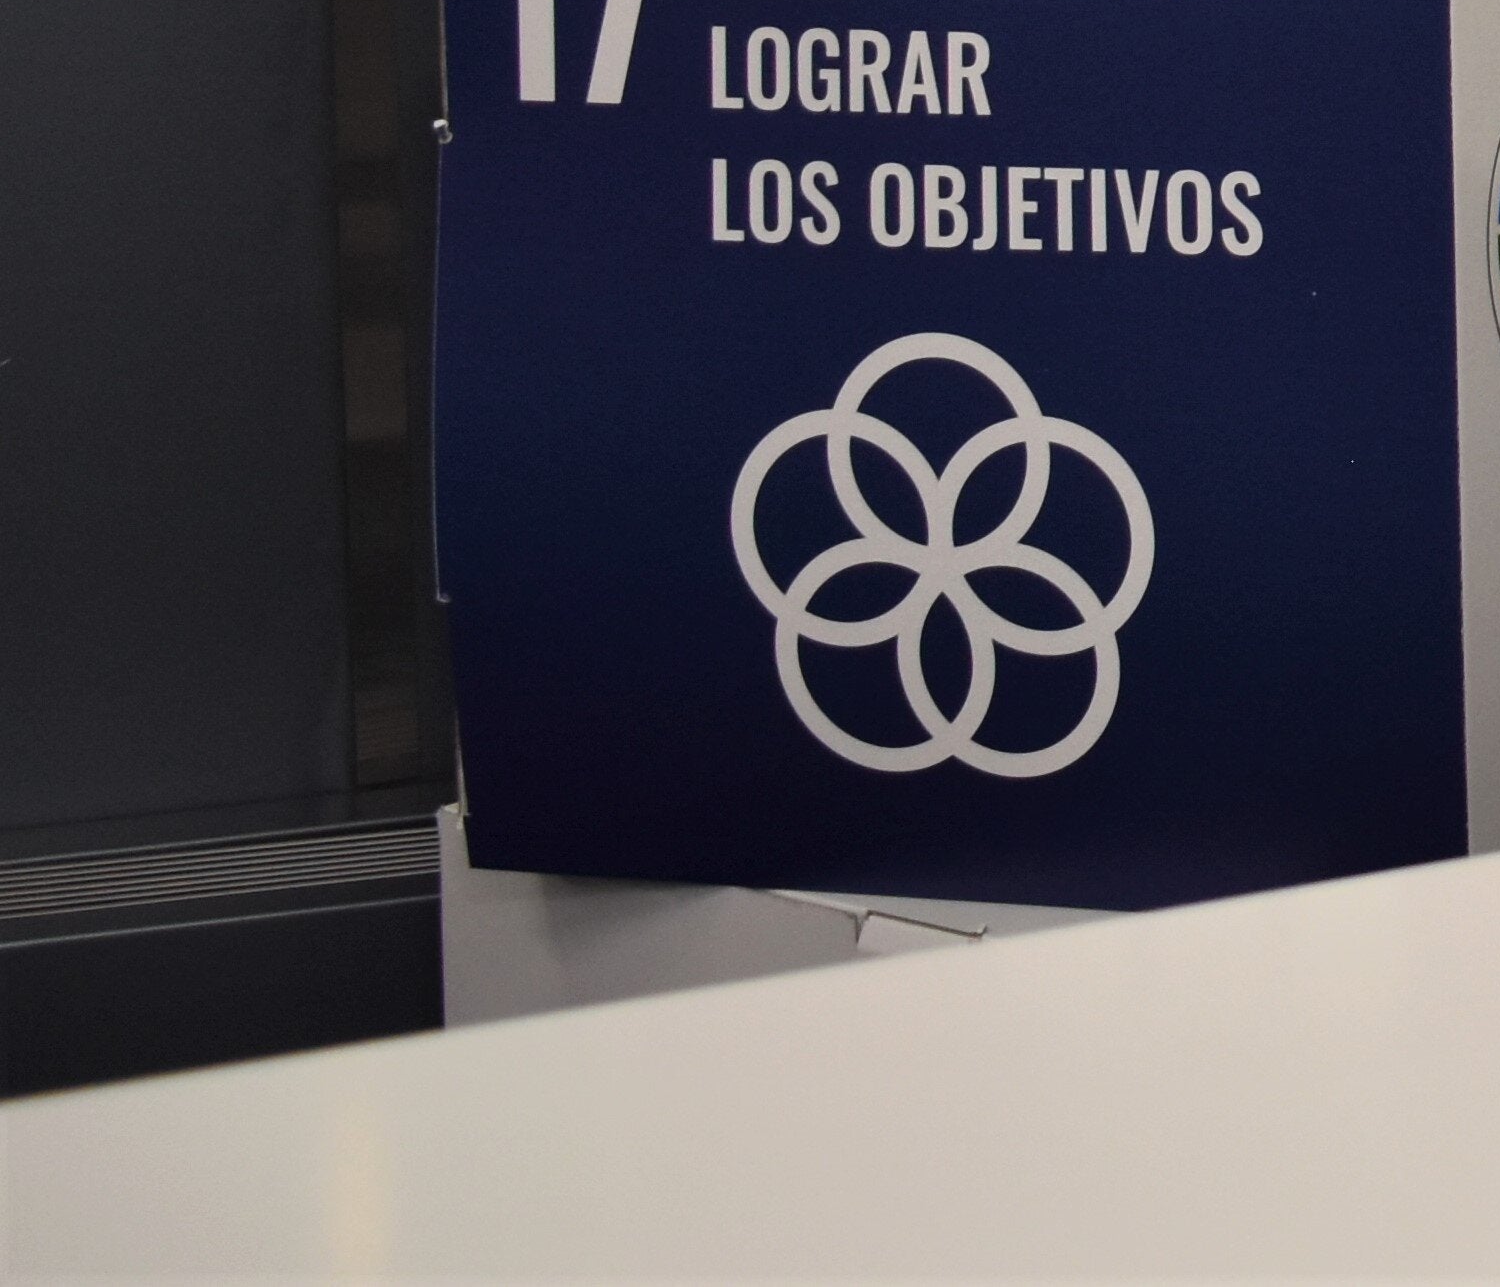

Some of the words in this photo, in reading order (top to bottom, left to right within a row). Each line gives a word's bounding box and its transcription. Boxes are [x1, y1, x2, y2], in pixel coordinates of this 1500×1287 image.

[711, 26, 991, 116] LOGRAR
[712, 158, 840, 246] LOS
[869, 163, 1264, 257] OBJETIVOS
